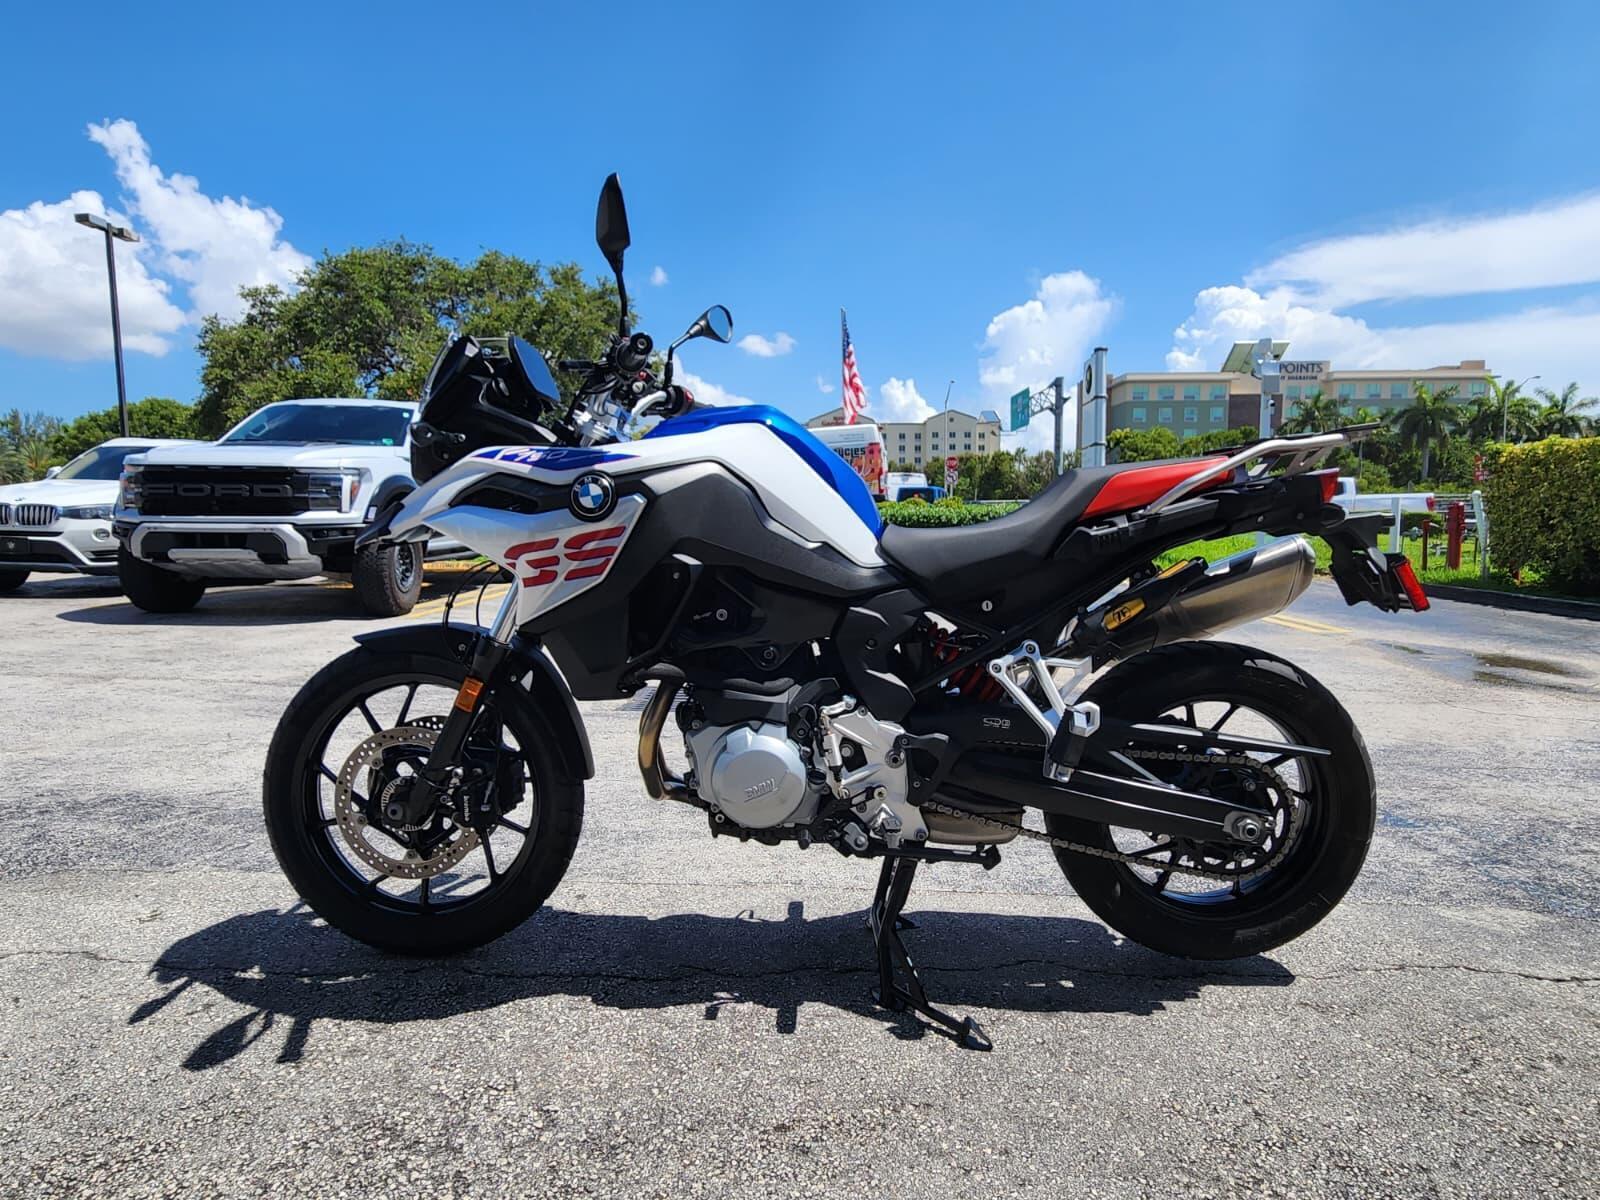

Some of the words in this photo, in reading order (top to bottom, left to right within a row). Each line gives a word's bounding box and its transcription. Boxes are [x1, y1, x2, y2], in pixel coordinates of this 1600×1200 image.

[1280, 363, 1323, 374] POINTS
[141, 483, 293, 497] FORD
[504, 526, 626, 588] GS
[744, 777, 776, 801] BMW
[463, 795, 471, 822] brembo
